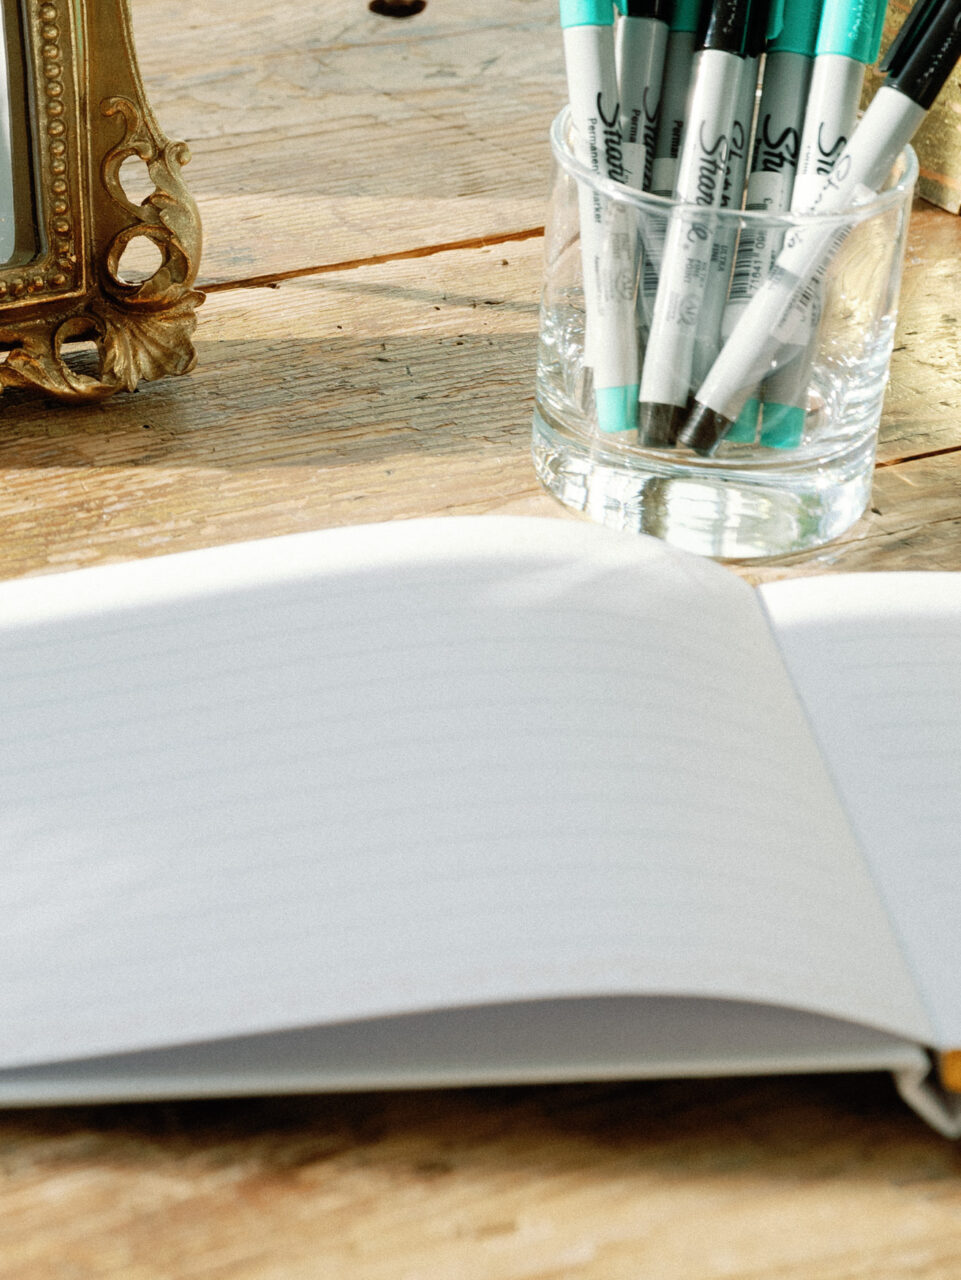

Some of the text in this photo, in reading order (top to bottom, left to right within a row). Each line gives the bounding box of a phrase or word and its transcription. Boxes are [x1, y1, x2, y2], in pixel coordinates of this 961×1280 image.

[629, 108, 641, 143] Perma
[669, 119, 683, 159] Perman
[589, 117, 602, 224] Permanen arker
[687, 119, 728, 243] Sharie
